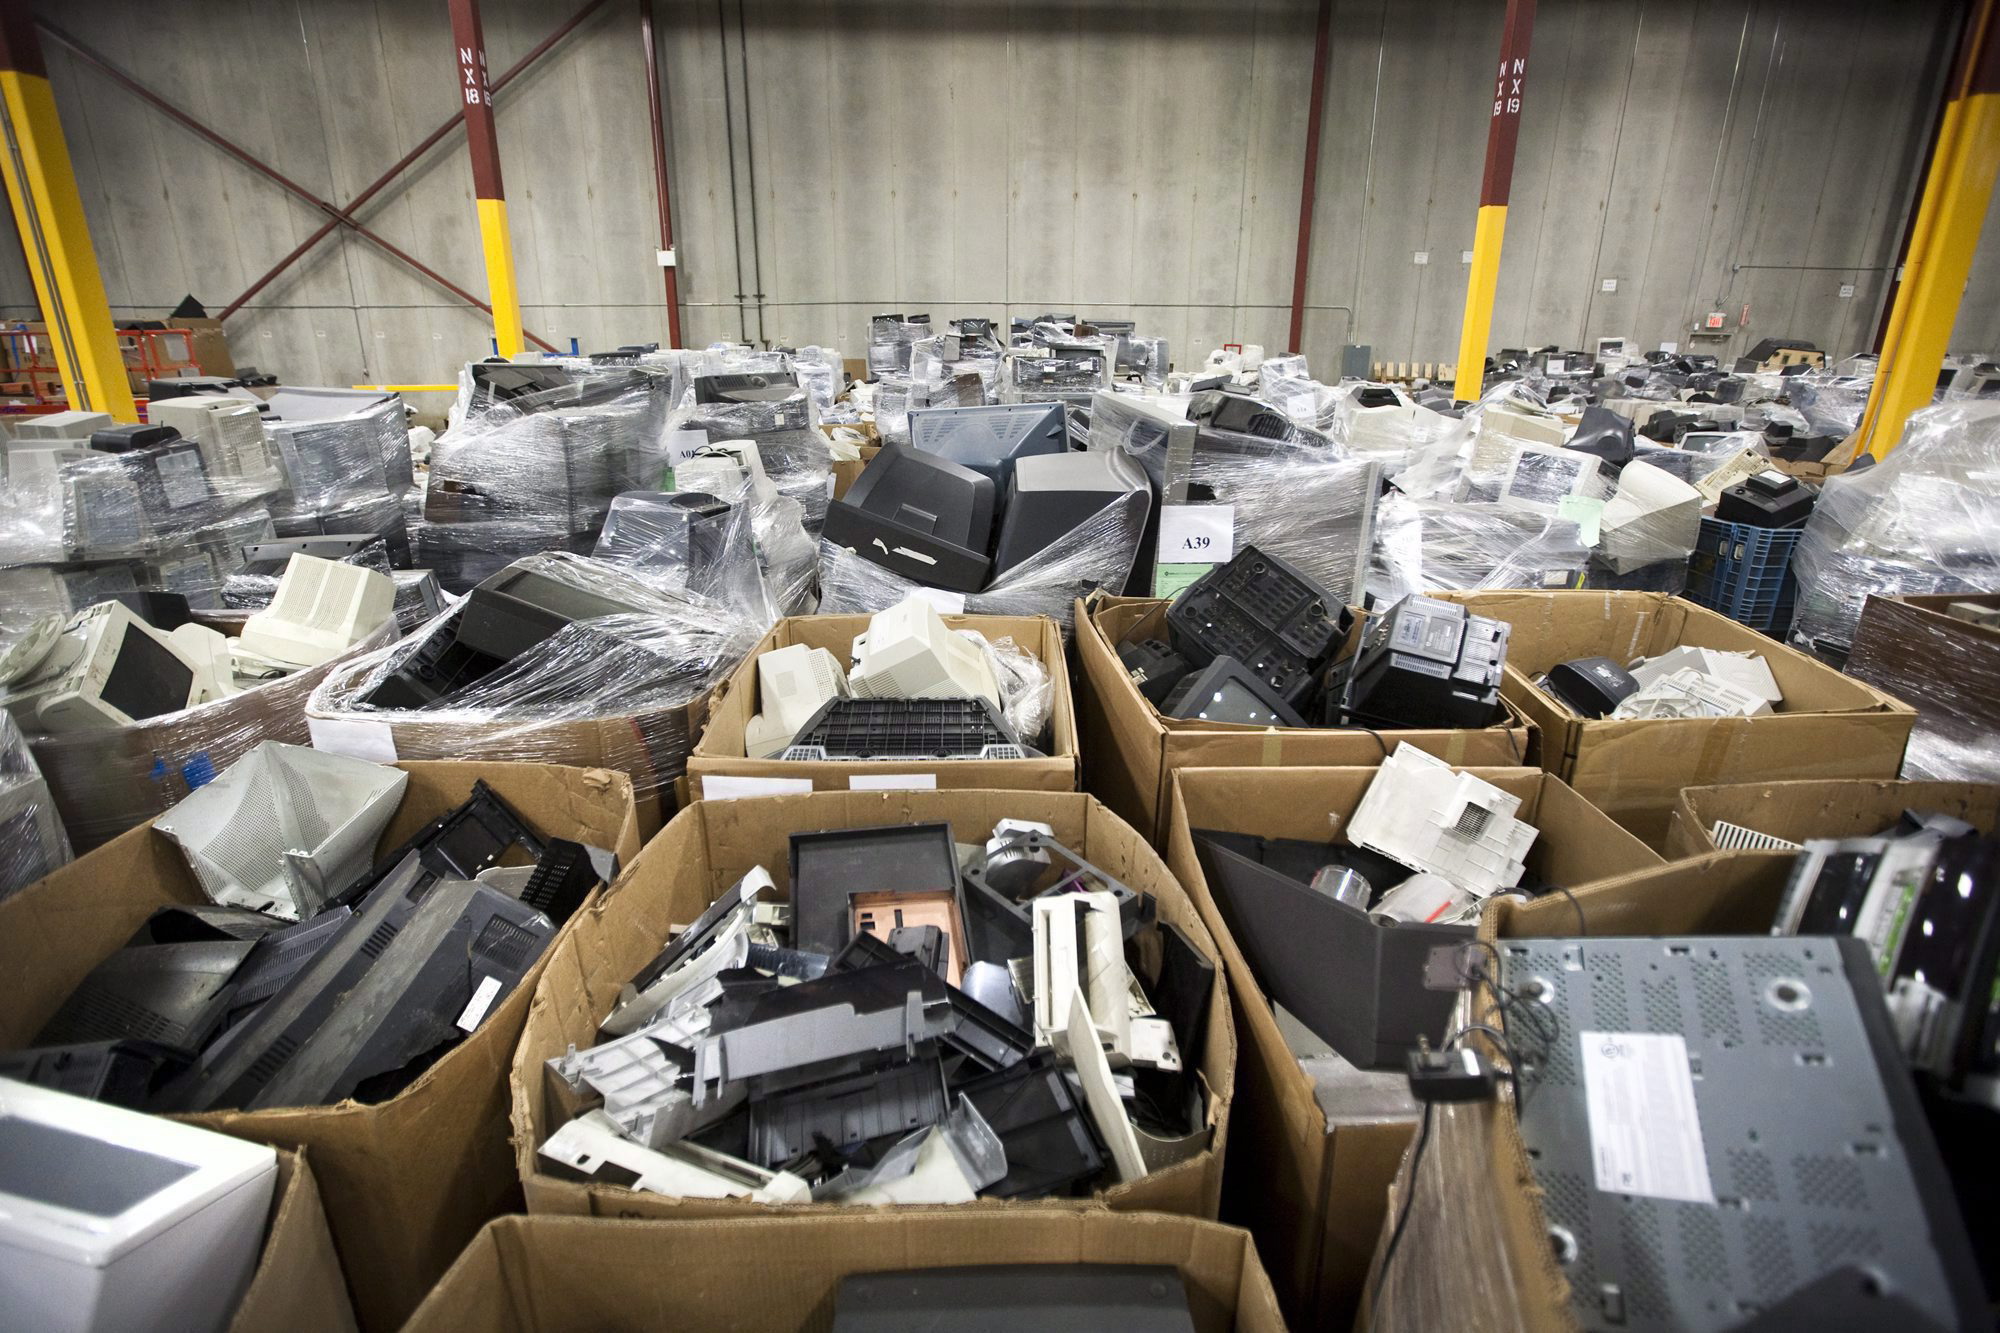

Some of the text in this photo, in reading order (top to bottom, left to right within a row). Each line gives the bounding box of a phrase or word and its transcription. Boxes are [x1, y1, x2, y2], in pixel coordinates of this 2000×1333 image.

[460, 47, 480, 104] N X 18
[1500, 61, 1507, 78] N
[1497, 81, 1504, 97] X
[1507, 58, 1525, 113] N X 19
[1182, 536, 1210, 549] A39
